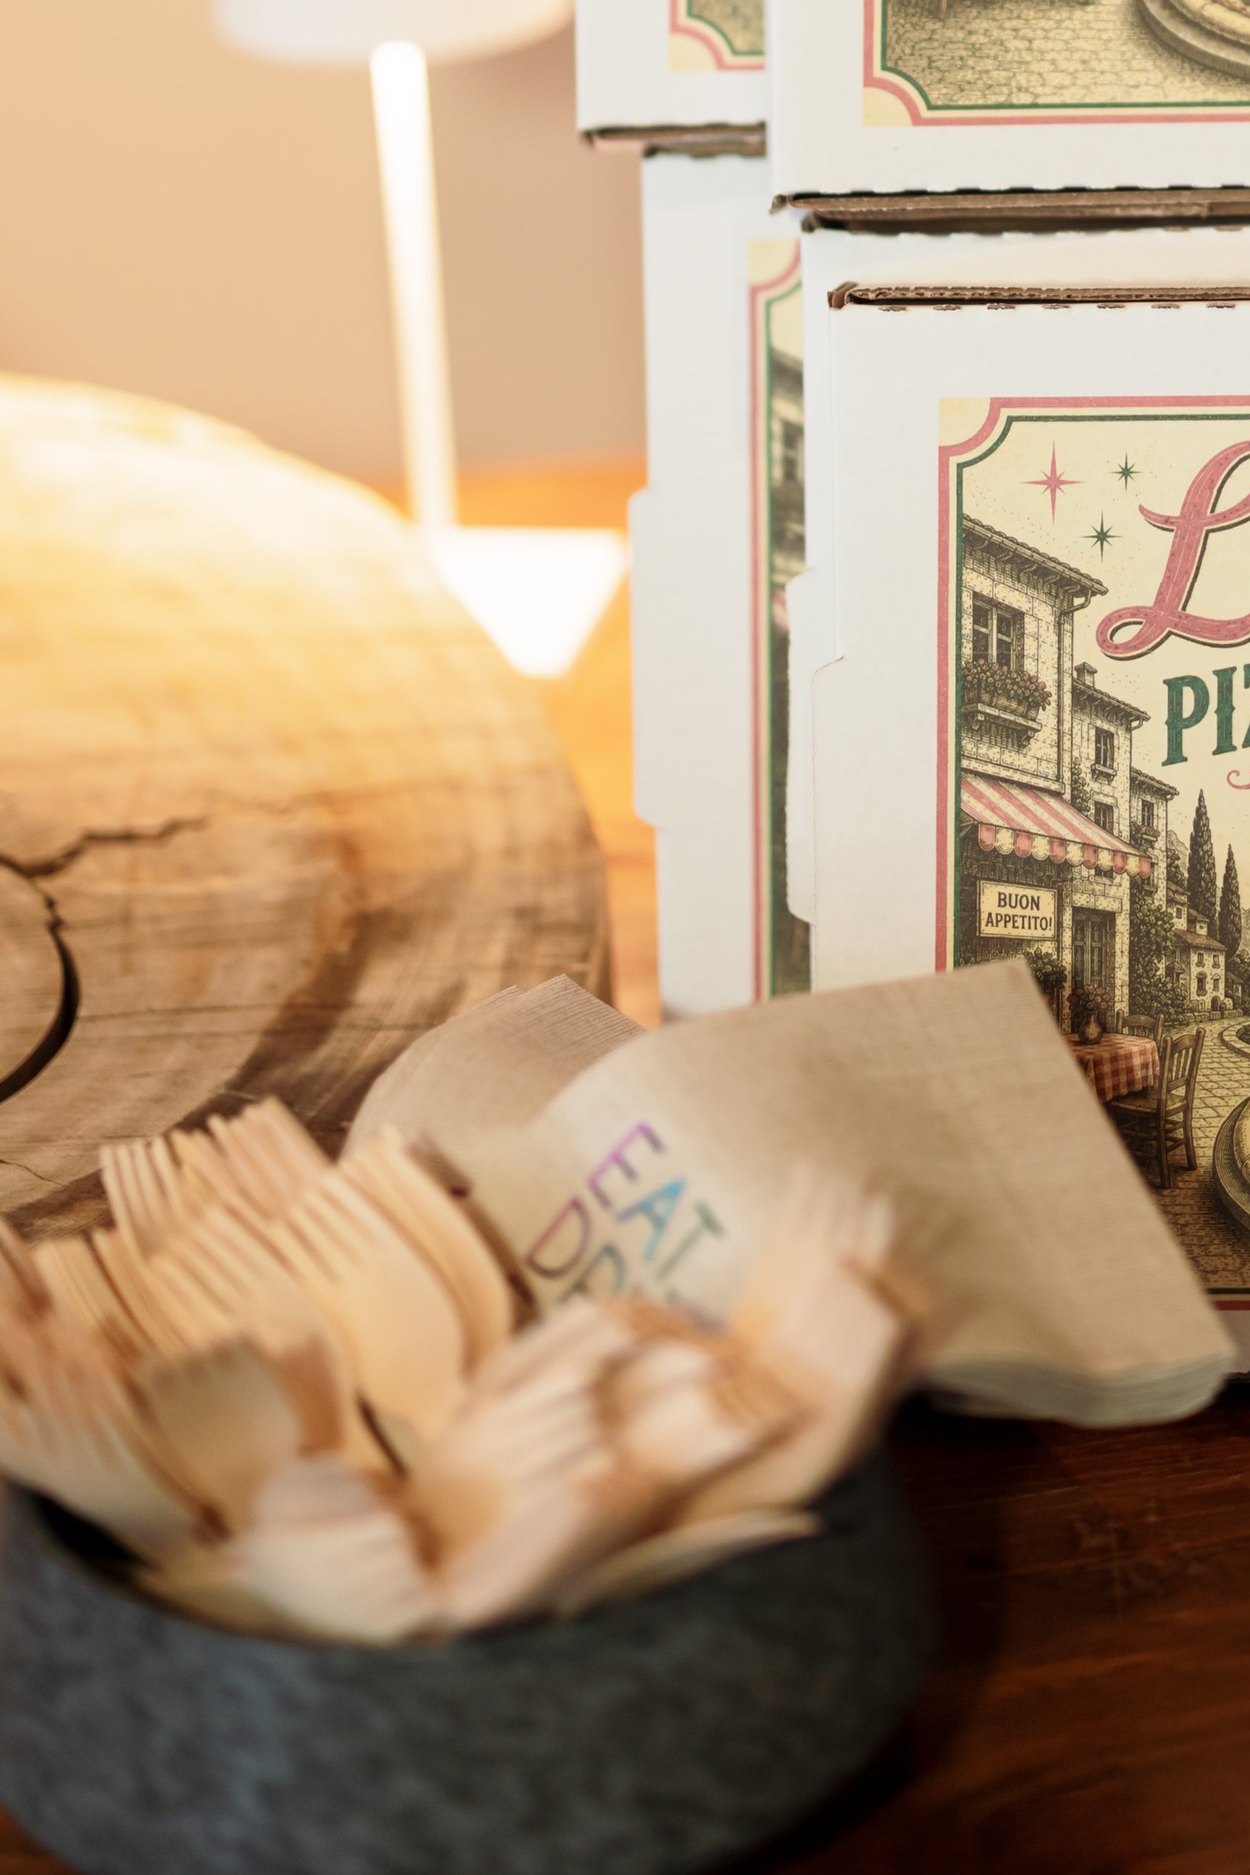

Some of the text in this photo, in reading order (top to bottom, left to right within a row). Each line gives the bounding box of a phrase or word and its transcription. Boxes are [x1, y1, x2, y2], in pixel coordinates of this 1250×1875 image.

[997, 891, 1041, 911] BUON
[984, 912, 1053, 931] APPETITO!
[587, 1121, 725, 1283] EAT
